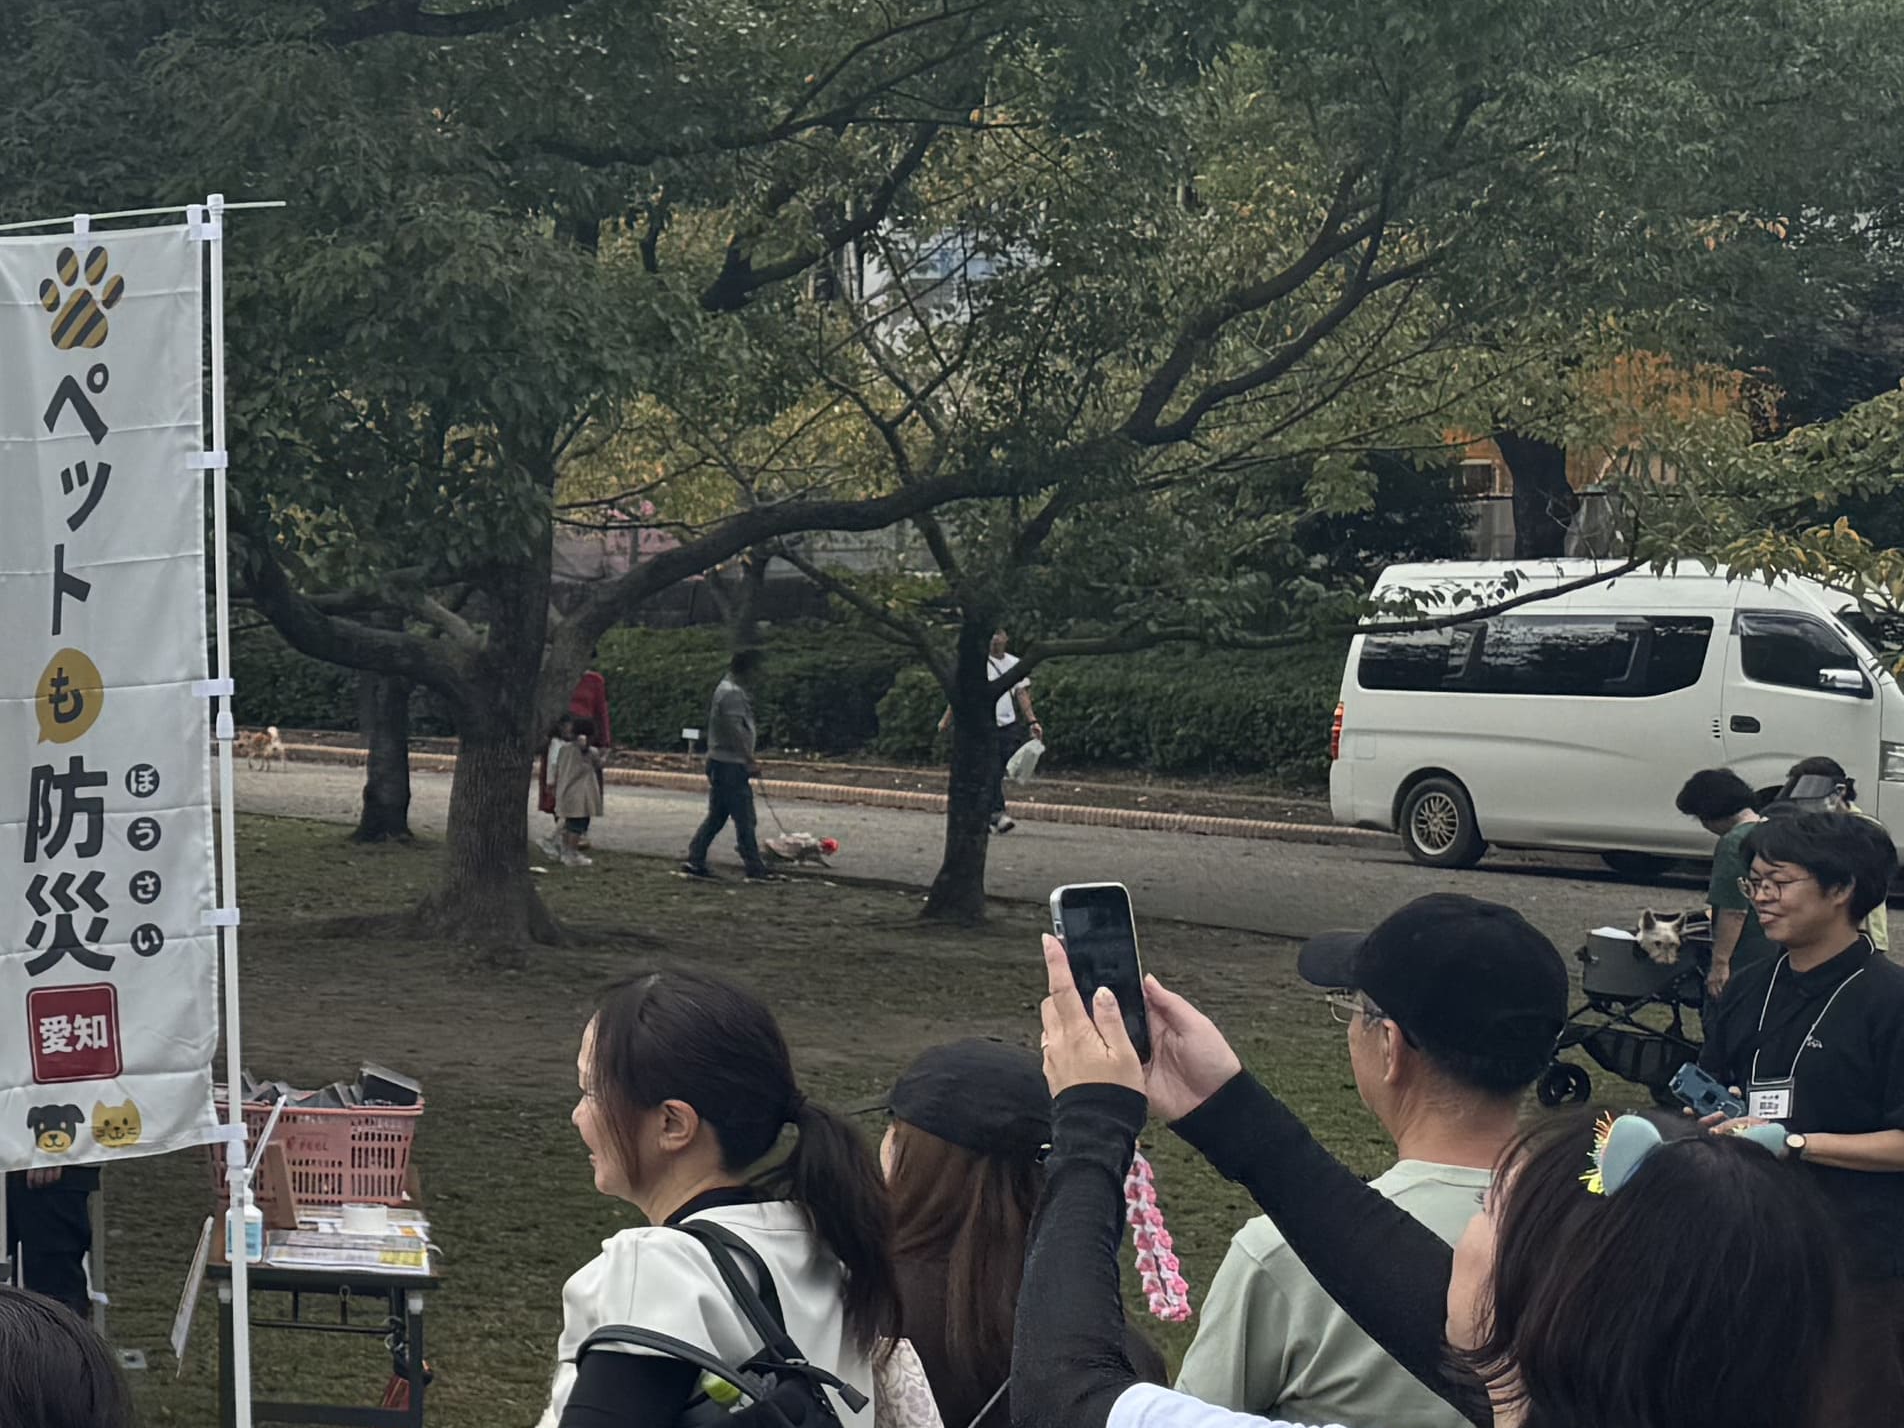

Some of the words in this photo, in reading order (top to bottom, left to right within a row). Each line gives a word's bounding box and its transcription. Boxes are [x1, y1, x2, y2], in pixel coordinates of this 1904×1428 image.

[24, 363, 115, 977] ペットも防災
[129, 765, 160, 953] ほうさい
[39, 1014, 108, 1055] 愛知
